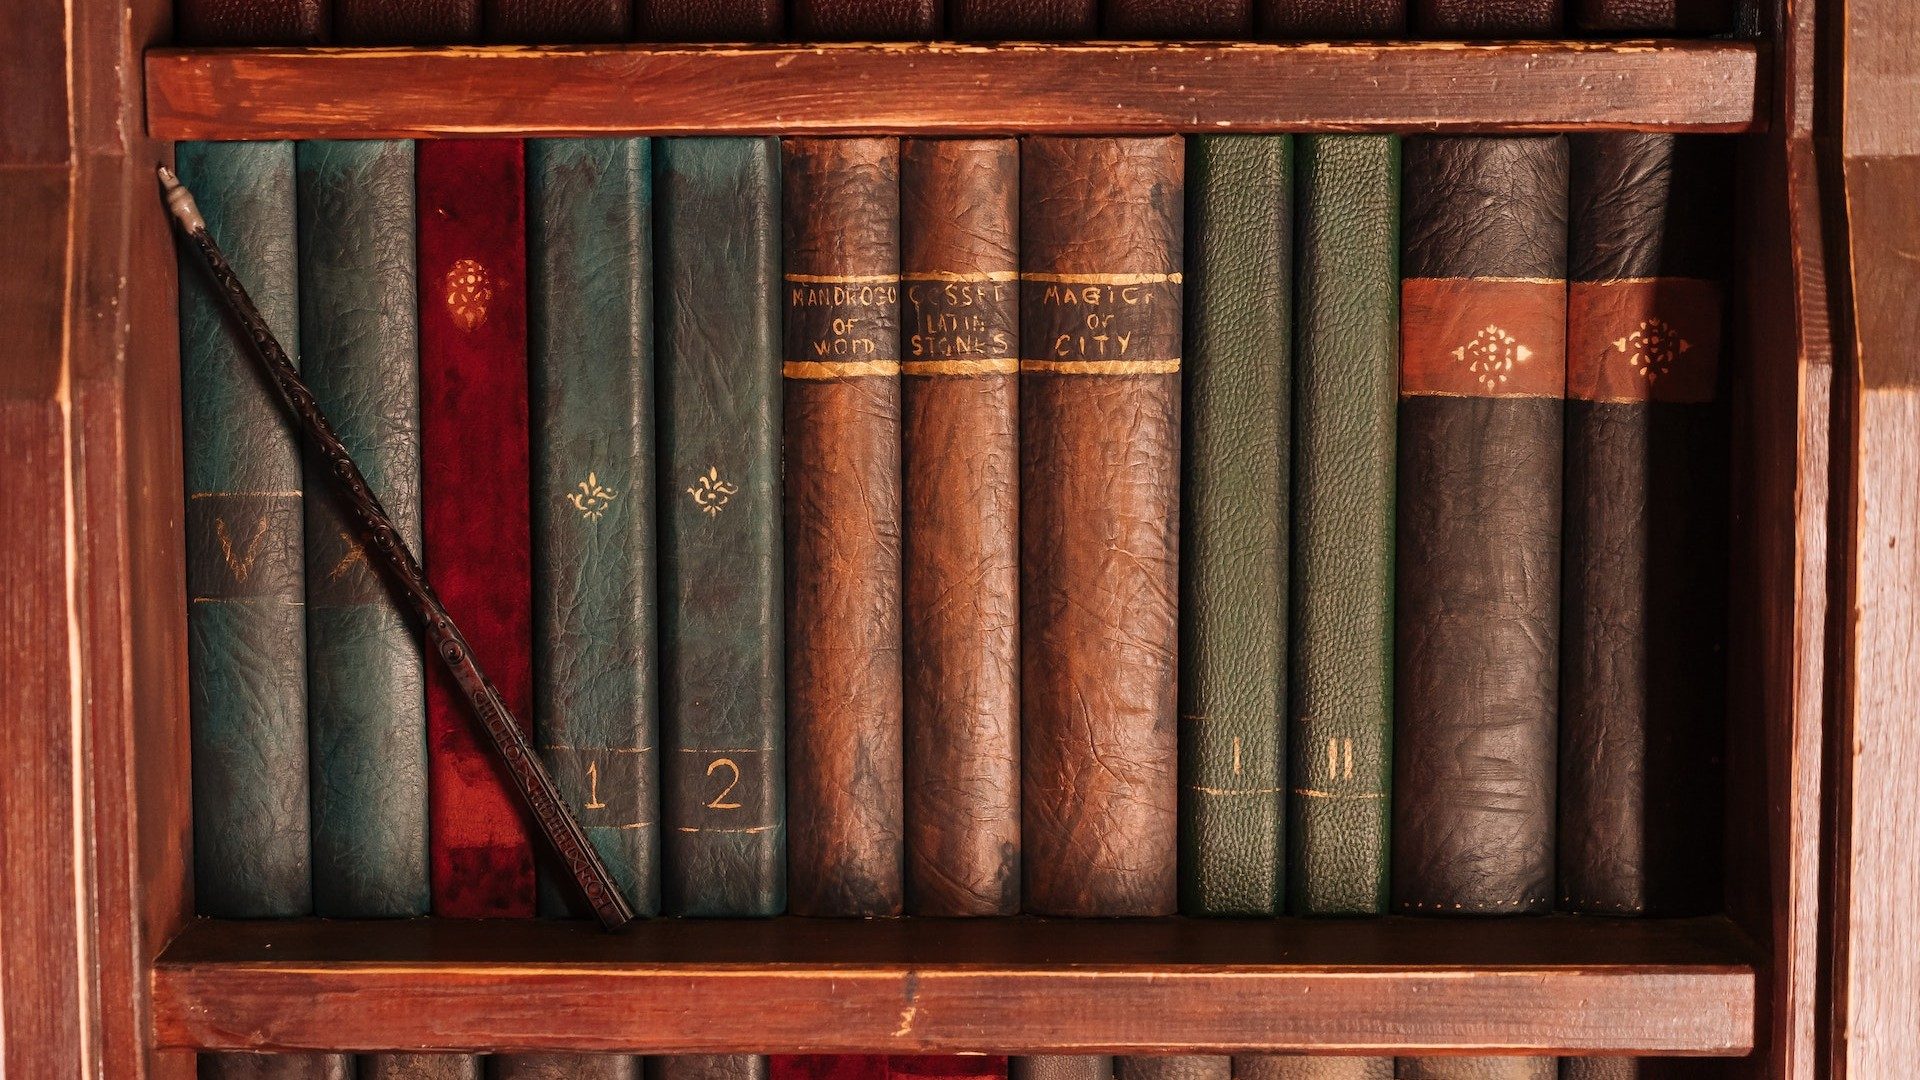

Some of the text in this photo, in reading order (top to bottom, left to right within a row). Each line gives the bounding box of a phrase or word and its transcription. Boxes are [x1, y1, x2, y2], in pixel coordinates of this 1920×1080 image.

[832, 318, 859, 335] OF
[1055, 331, 1131, 356] CITY
[1328, 737, 1352, 780] II
[585, 760, 606, 809] 1
[706, 757, 742, 809] 2
